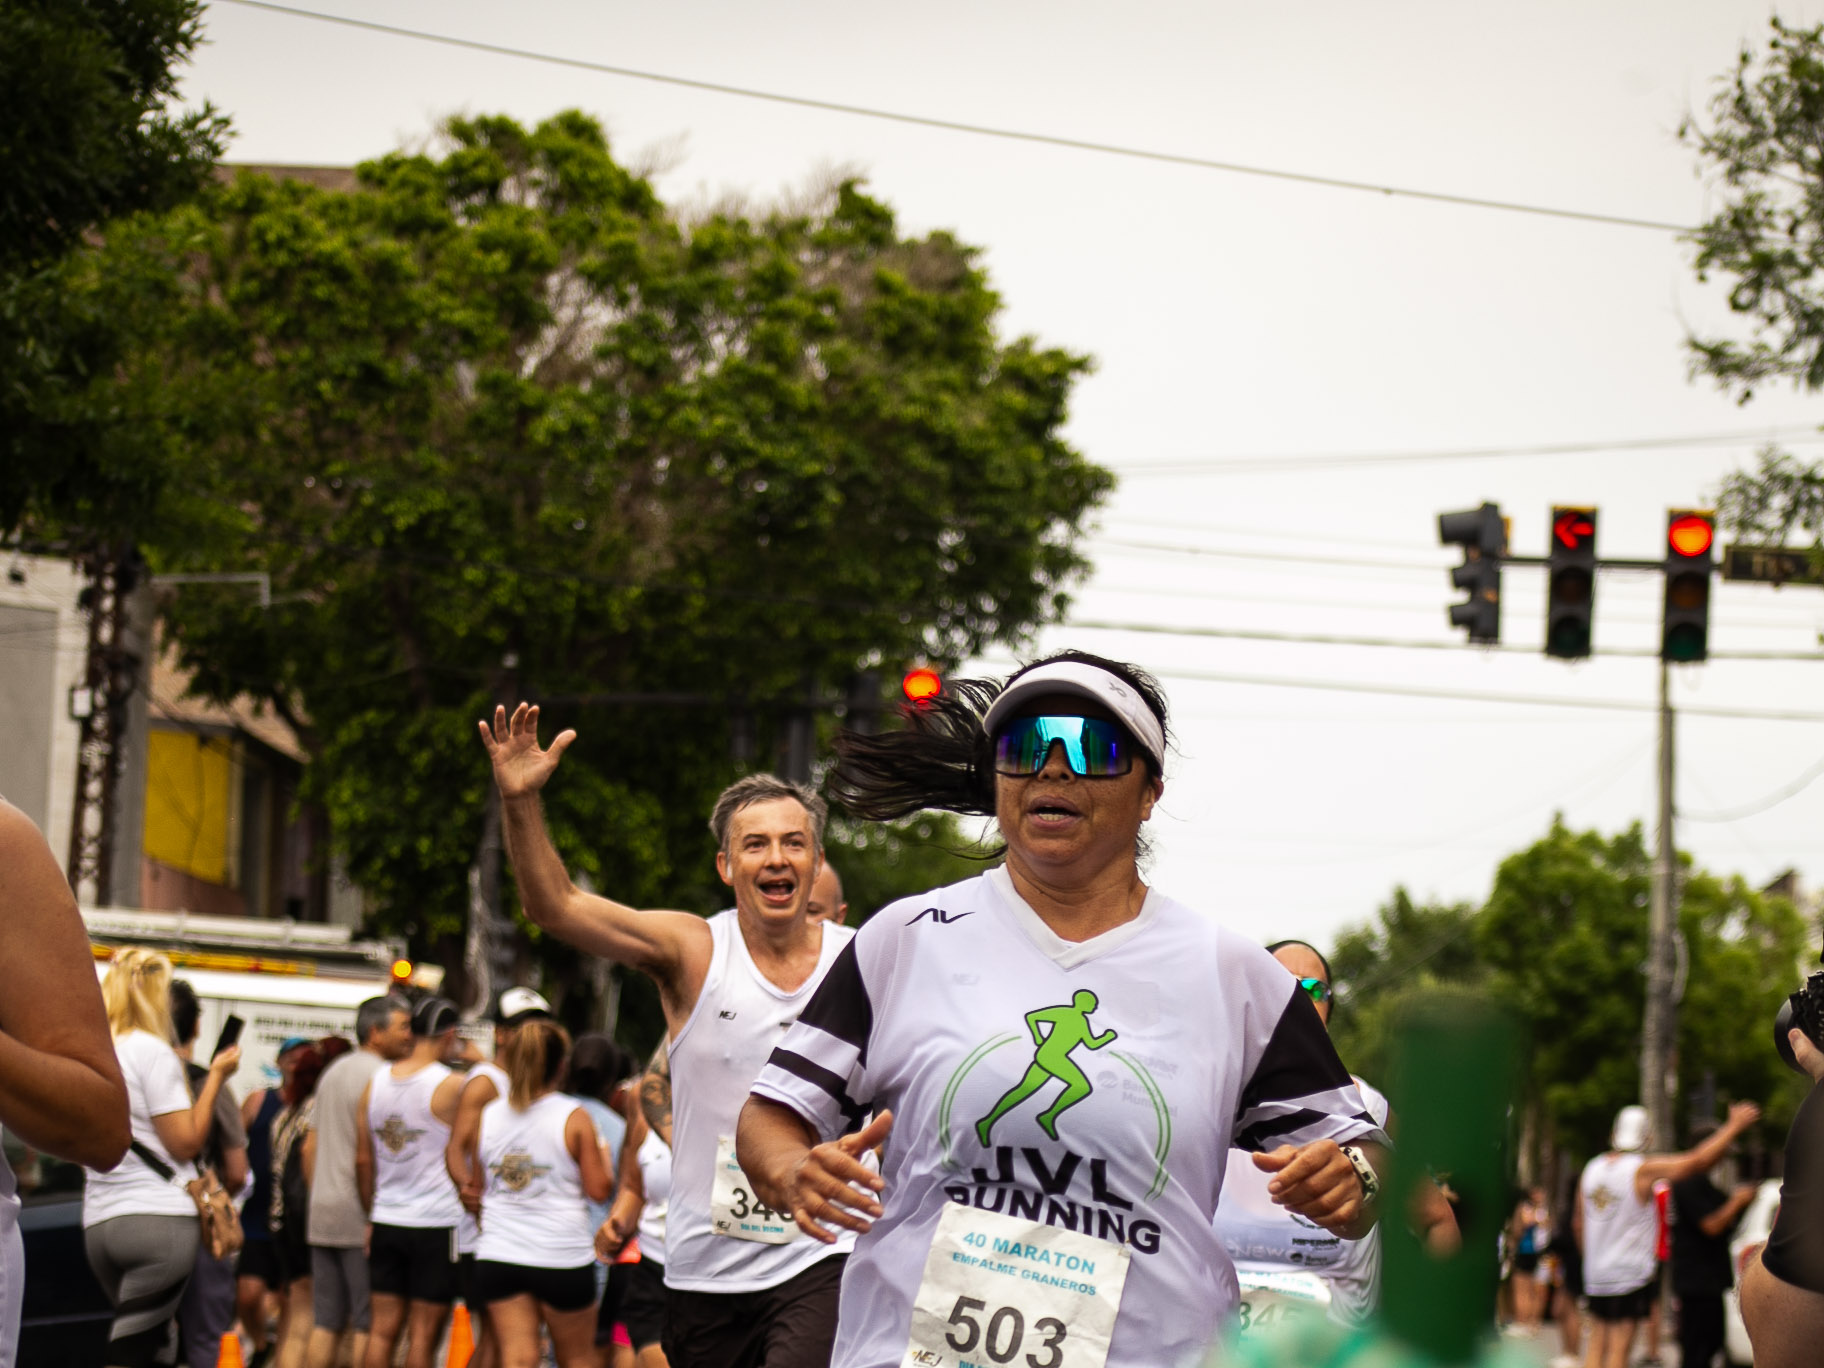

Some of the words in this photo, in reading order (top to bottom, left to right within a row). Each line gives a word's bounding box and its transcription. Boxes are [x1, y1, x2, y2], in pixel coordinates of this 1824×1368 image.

[971, 1146, 1133, 1211] JVL
[730, 1187, 794, 1222] 34
[944, 1186, 1161, 1255] RUNNING
[952, 1252, 1018, 1277] EMPALME
[1021, 1268, 1097, 1296] GRANEROS
[963, 1231, 986, 1248] 40
[992, 1237, 1096, 1276] MARATON
